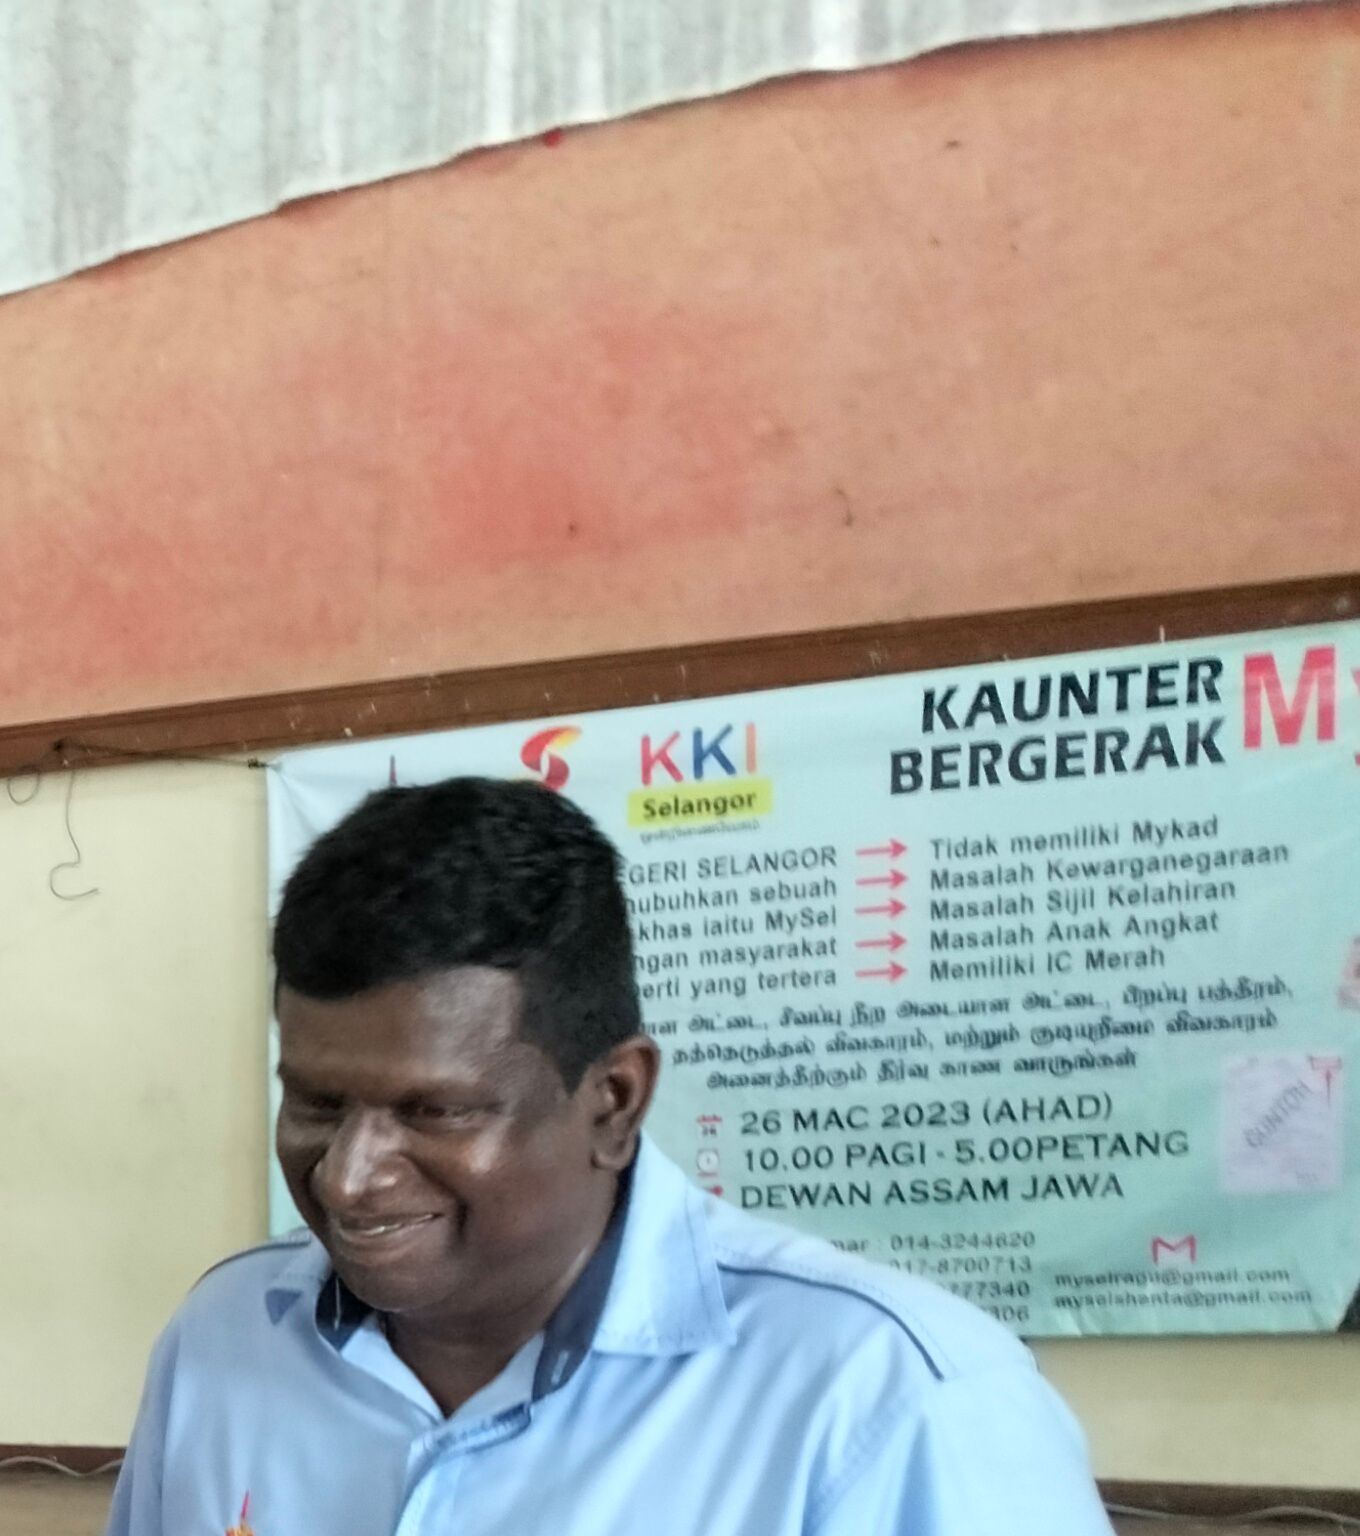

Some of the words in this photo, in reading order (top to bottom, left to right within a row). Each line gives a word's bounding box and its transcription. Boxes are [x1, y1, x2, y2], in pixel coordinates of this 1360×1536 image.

[921, 656, 1224, 734] KAUNTER
[640, 722, 758, 787] KKI
[889, 716, 1227, 796] BERGERAK
[642, 789, 758, 821] Selangor
[929, 835, 998, 862] Tidak
[1010, 823, 1121, 855] memiliki
[1131, 814, 1220, 847] Mykad
[696, 845, 838, 880] SELANGOR
[930, 862, 1035, 891] Masalah
[1046, 843, 1291, 883] Kewarganegaraan
[749, 877, 838, 902] sebuah
[930, 893, 1035, 922] Masalah
[1046, 884, 1097, 915] Sijil
[1107, 878, 1238, 909] Kelahiran
[638, 917, 693, 942] khas
[703, 913, 755, 938] iaitu
[764, 908, 838, 935] MySel
[930, 924, 1035, 953] Masalah
[1046, 918, 1112, 944] Anak
[1124, 909, 1221, 943] Angkat
[634, 951, 689, 975] ngan
[698, 938, 838, 967] masyarakat
[930, 953, 1036, 983] Memiliki
[1047, 949, 1073, 975] IC
[1084, 942, 1166, 972] Merah
[689, 973, 748, 1001] yang
[757, 966, 838, 992] tertera
[740, 1110, 782, 1136] 26
[792, 1105, 869, 1134] MAC
[879, 1100, 971, 1129] 2023
[981, 1092, 1114, 1126] (AHAD)
[743, 1146, 834, 1174] 10.00
[844, 1142, 927, 1170] PAGI
[740, 1181, 873, 1210] DEWAN
[883, 1176, 1010, 1205] ASSAM
[1019, 1171, 1126, 1201] JAWA
